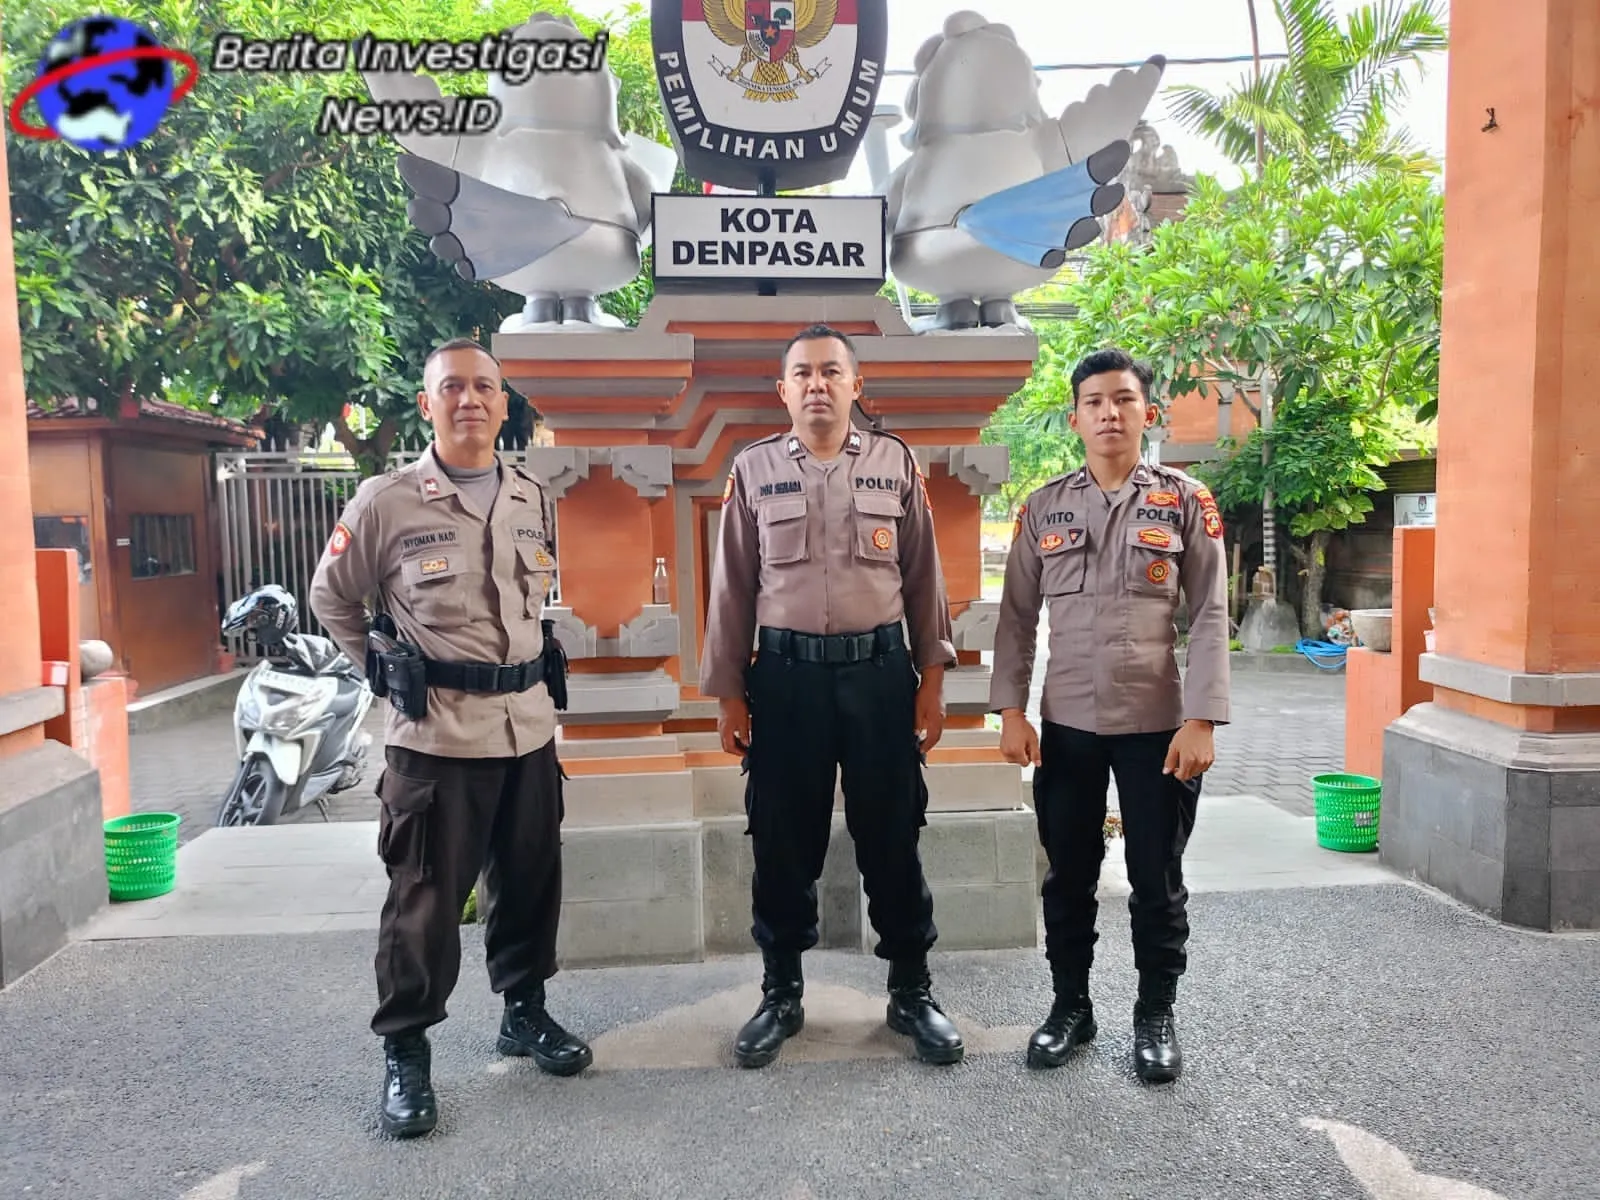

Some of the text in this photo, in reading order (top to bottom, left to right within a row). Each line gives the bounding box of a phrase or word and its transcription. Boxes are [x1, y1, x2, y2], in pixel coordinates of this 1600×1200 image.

[659, 51, 879, 160] PEMILIHAN UMUM
[720, 207, 817, 234] KOTA
[672, 240, 865, 267] DENPASAR
[855, 477, 898, 492] POLRI
[1045, 511, 1075, 525] VITO
[1136, 507, 1182, 526] POLRI
[403, 533, 436, 549] NYOMAN
